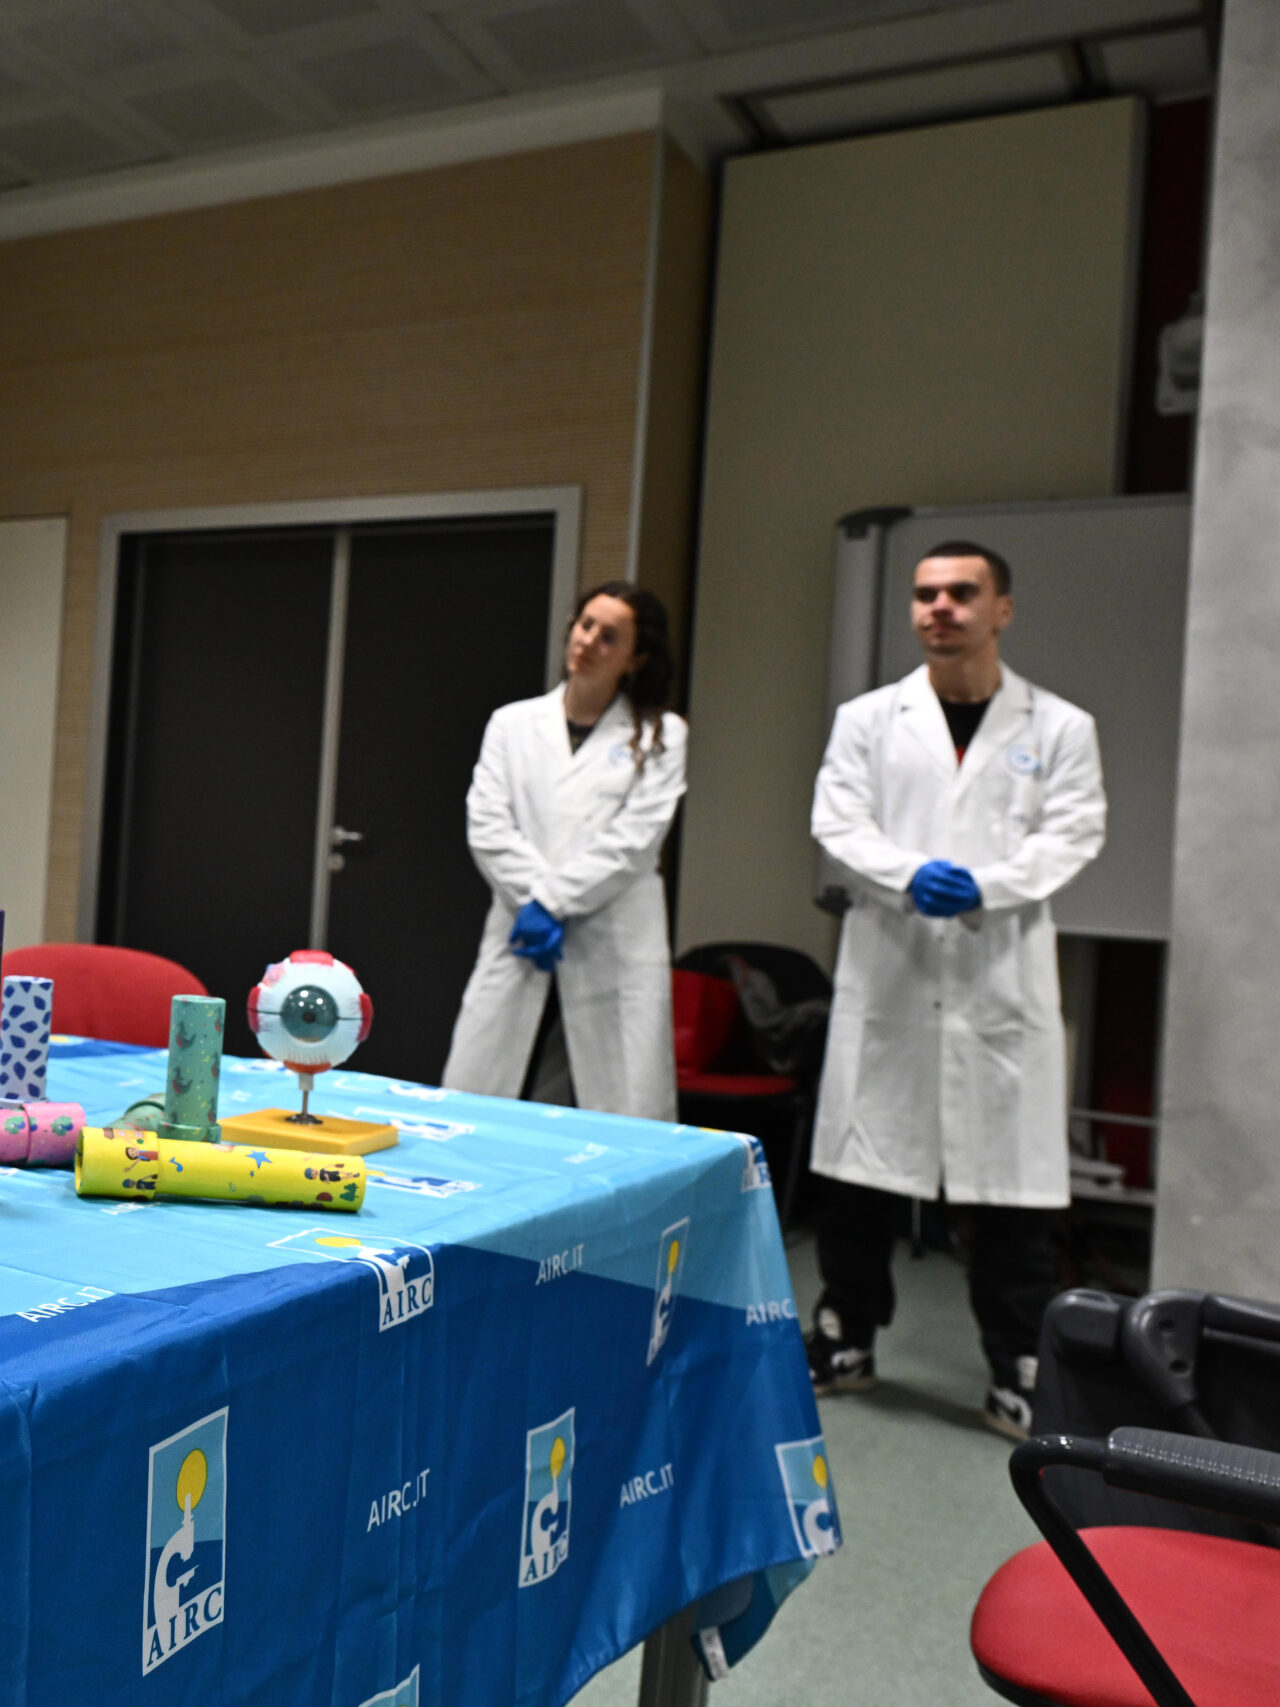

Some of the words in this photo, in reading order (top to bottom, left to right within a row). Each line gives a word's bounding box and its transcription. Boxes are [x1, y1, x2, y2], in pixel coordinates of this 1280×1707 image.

[535, 1243, 584, 1286] AIRC.IT
[16, 1286, 113, 1323] AIRC.IT
[382, 1276, 432, 1326] AIRC
[366, 1468, 431, 1532] AIRC.IT
[620, 1463, 674, 1509] AIRC.IT
[147, 1586, 223, 1668] AIRC
